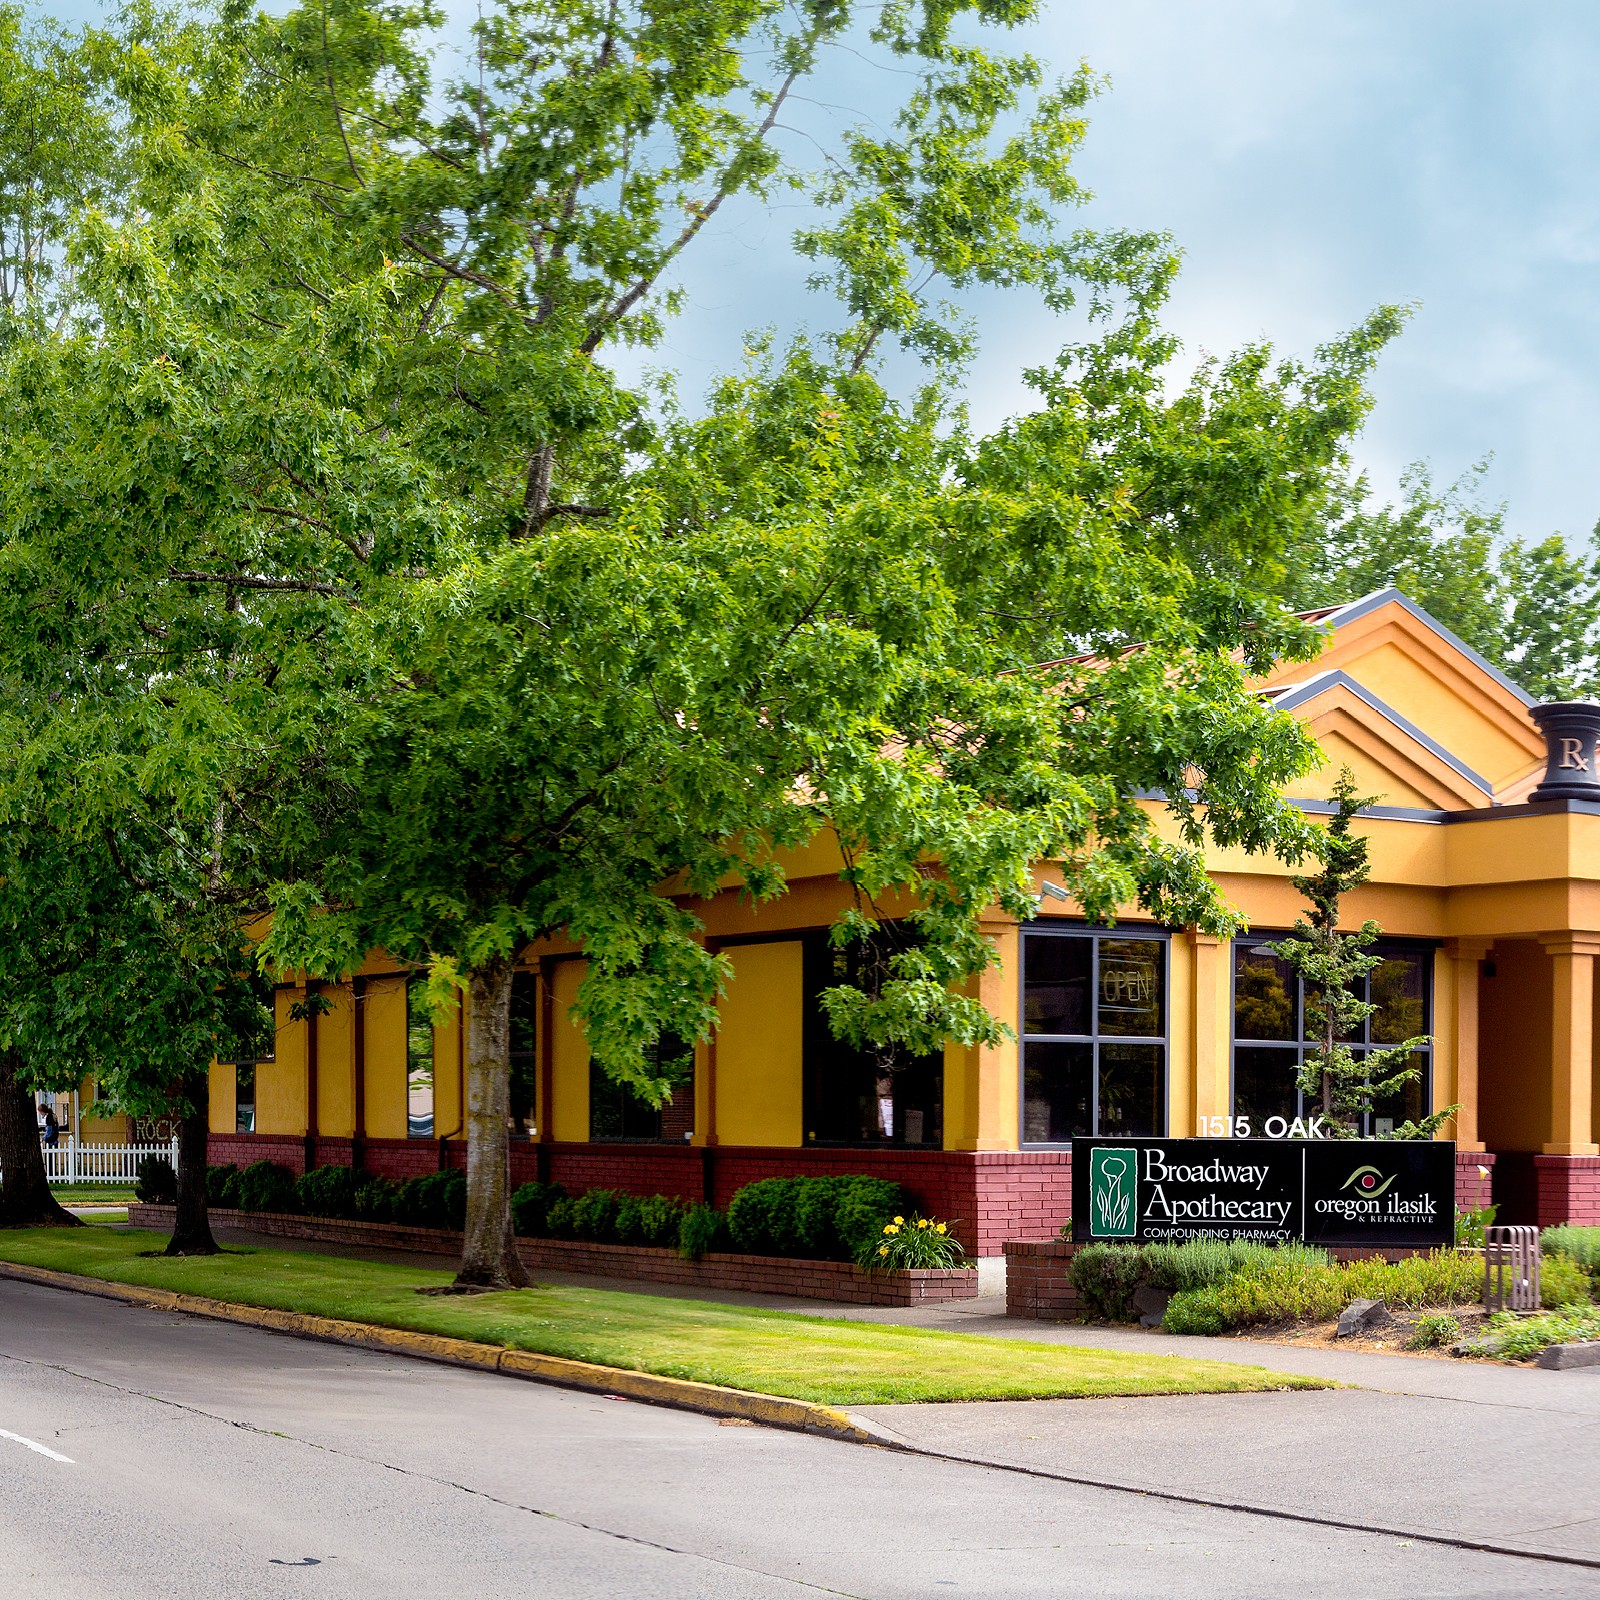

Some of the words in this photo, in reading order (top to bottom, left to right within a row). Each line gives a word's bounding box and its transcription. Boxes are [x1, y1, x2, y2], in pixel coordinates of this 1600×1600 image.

[1103, 970, 1149, 1001] OPEN
[136, 1119, 181, 1141] ROCK
[1200, 1115, 1251, 1139] 1515
[1264, 1115, 1326, 1139] OAK
[1143, 1148, 1270, 1191] Broadway
[1143, 1184, 1292, 1227] Apothecary
[1314, 1199, 1380, 1220] oregon
[1387, 1191, 1437, 1214] ilasik
[1358, 1215, 1366, 1223] &
[1370, 1215, 1434, 1223] REFRACTIVE
[1143, 1227, 1230, 1239] COMPOUNDING
[1232, 1229, 1292, 1240] PHARMACY
